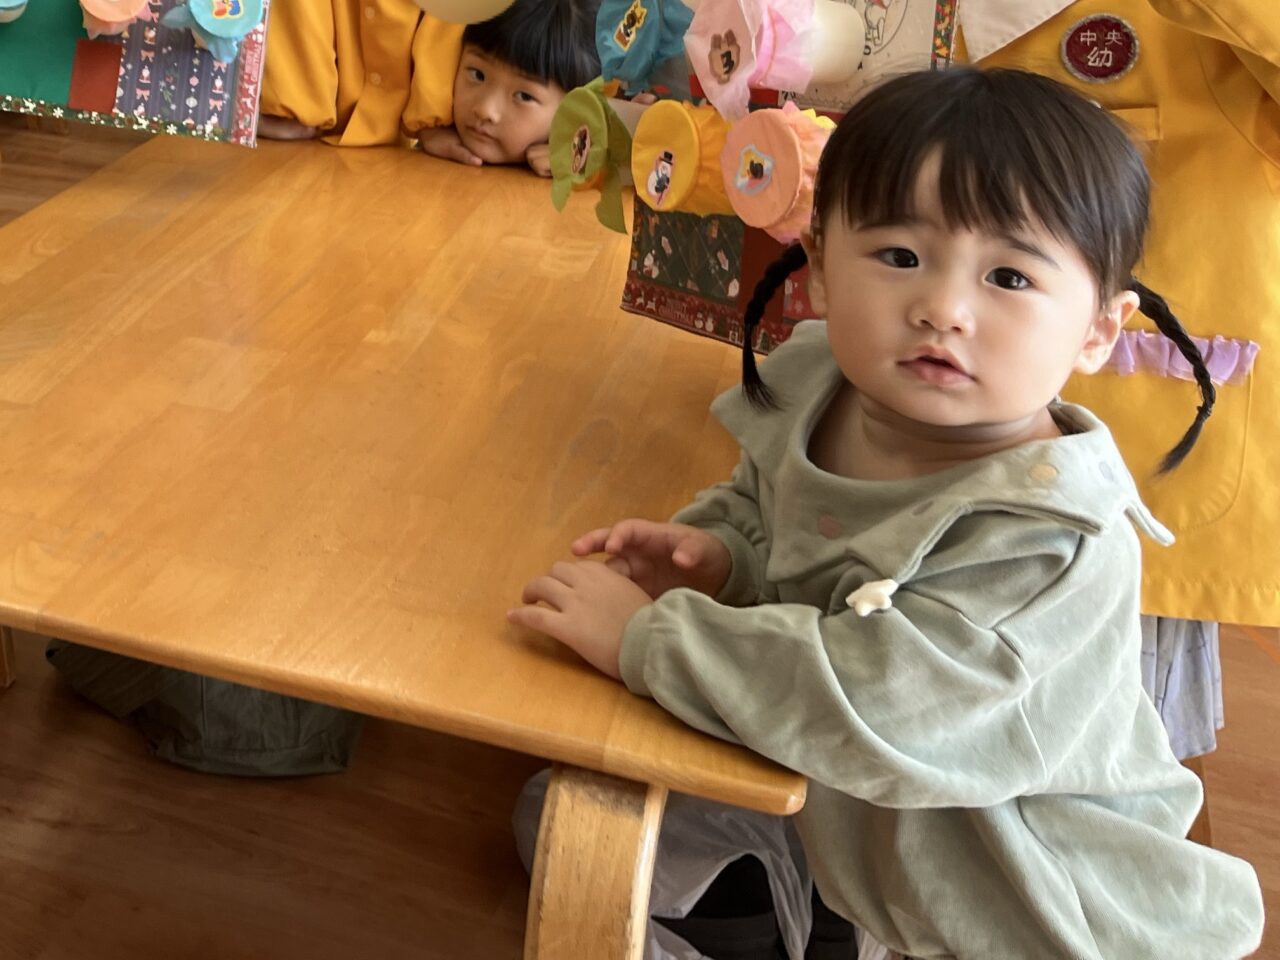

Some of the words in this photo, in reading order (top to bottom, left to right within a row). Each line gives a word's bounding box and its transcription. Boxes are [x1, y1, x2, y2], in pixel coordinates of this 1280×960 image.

[1080, 29, 1123, 46] 中央
[720, 50, 735, 74] 3
[1087, 46, 1113, 68] 幼
